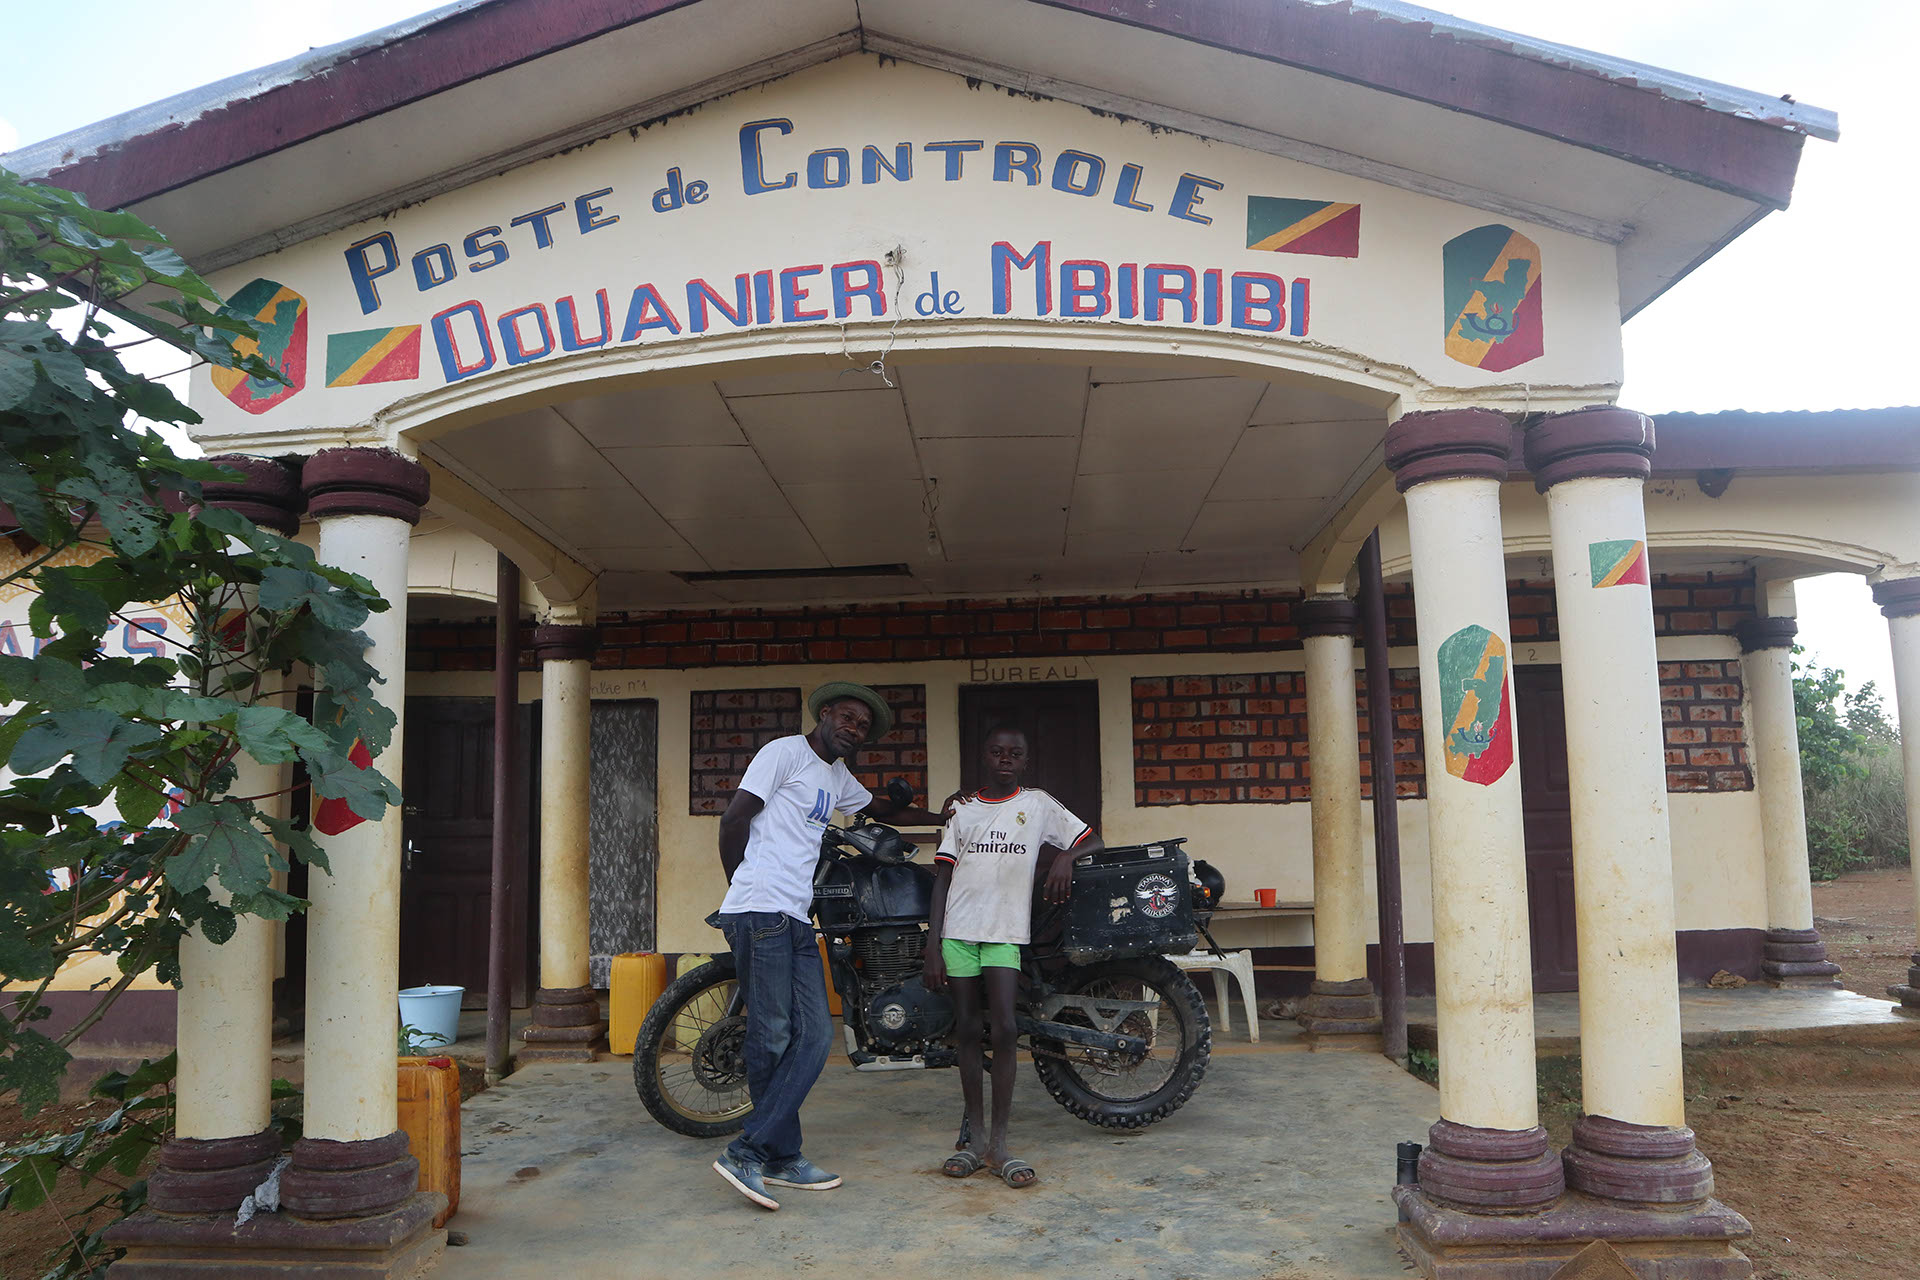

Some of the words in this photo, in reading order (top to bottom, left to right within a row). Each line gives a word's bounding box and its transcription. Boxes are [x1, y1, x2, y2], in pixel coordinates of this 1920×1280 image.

[652, 166, 710, 214] de
[430, 259, 888, 384] DOUANIER
[914, 270, 966, 317] de
[991, 240, 1312, 338] MBIRIBI
[1527, 648, 1539, 662] 2
[970, 659, 1078, 682] BUREAU
[989, 830, 1007, 841] Fly
